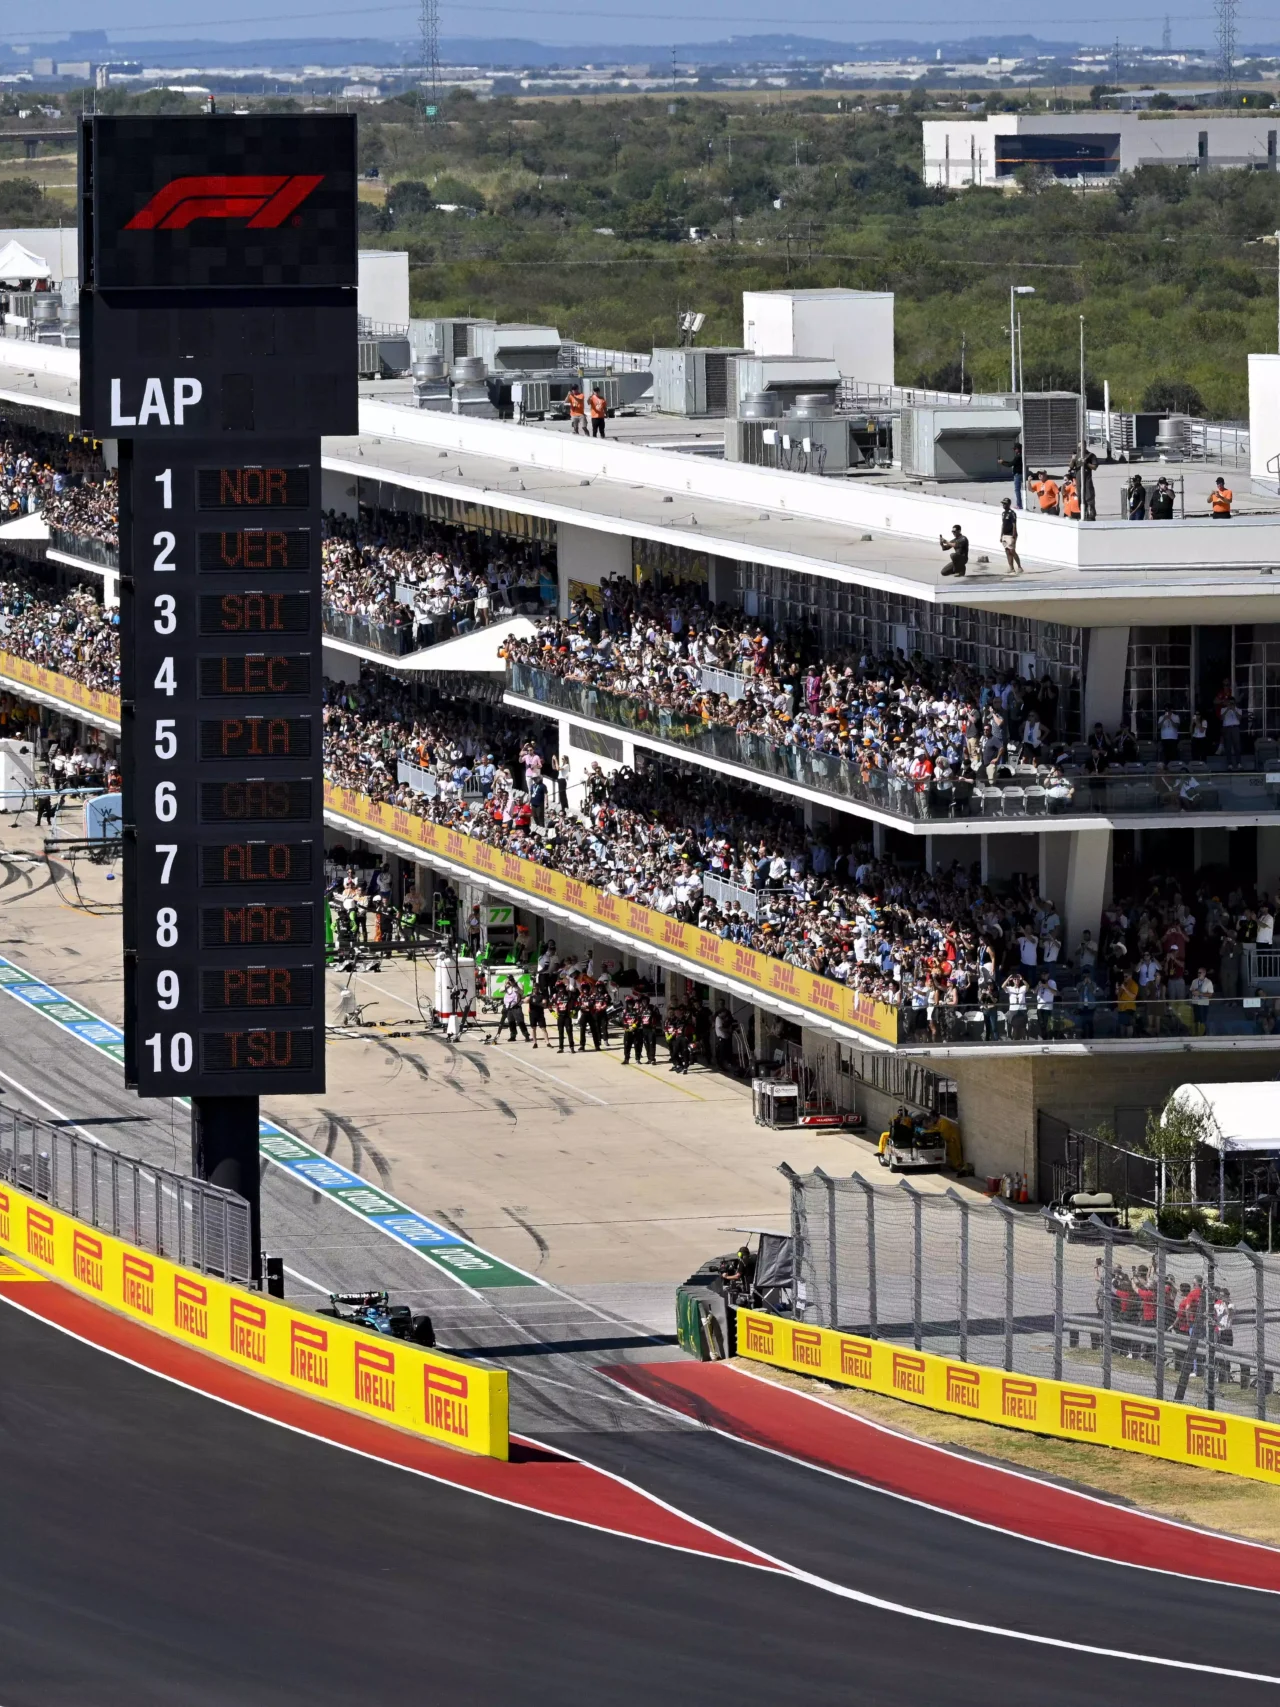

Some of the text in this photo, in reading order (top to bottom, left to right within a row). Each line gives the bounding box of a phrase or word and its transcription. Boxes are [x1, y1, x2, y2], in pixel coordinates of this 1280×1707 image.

[110, 377, 203, 427] LAP
[155, 468, 287, 509] 1 NOR
[153, 531, 176, 572] 2
[153, 594, 284, 635] 3 SAI
[154, 656, 289, 696] 4 LEC
[154, 719, 290, 760] 5 PIA
[155, 781, 178, 822] 6
[155, 844, 290, 884] 7 ALO
[156, 907, 291, 948] 8 MAG
[489, 908, 513, 923] 77
[697, 935, 723, 965] DHL
[733, 948, 760, 980] DHL
[156, 969, 291, 1010] 9 PER
[770, 964, 799, 996] DHL
[809, 980, 838, 1012] DHL
[145, 1032, 292, 1073] 10 TSU
[27, 1206, 54, 1265] PIRELLI
[73, 1229, 103, 1291] PIRELLI
[430, 1248, 494, 1270] aramco
[123, 1252, 154, 1316] PIRELLI
[174, 1274, 208, 1340] PIRELLI
[230, 1297, 266, 1365] PIRELLI
[746, 1317, 774, 1356] PIRELLI
[792, 1328, 821, 1367] PIRELLI
[290, 1319, 328, 1388] PIRELLI
[840, 1340, 872, 1380] PIRELLI
[354, 1341, 395, 1413] PIRELLI
[893, 1353, 925, 1396] PIRELLI
[947, 1366, 980, 1410] PIRELLI
[423, 1363, 469, 1438] PIRELLI
[1002, 1379, 1037, 1421] PIRELLI
[1060, 1391, 1097, 1433] PIRELLI
[1121, 1401, 1161, 1446] PIRELLI
[1186, 1414, 1227, 1461] PIRELLI
[1254, 1427, 1280, 1475] PIRE
